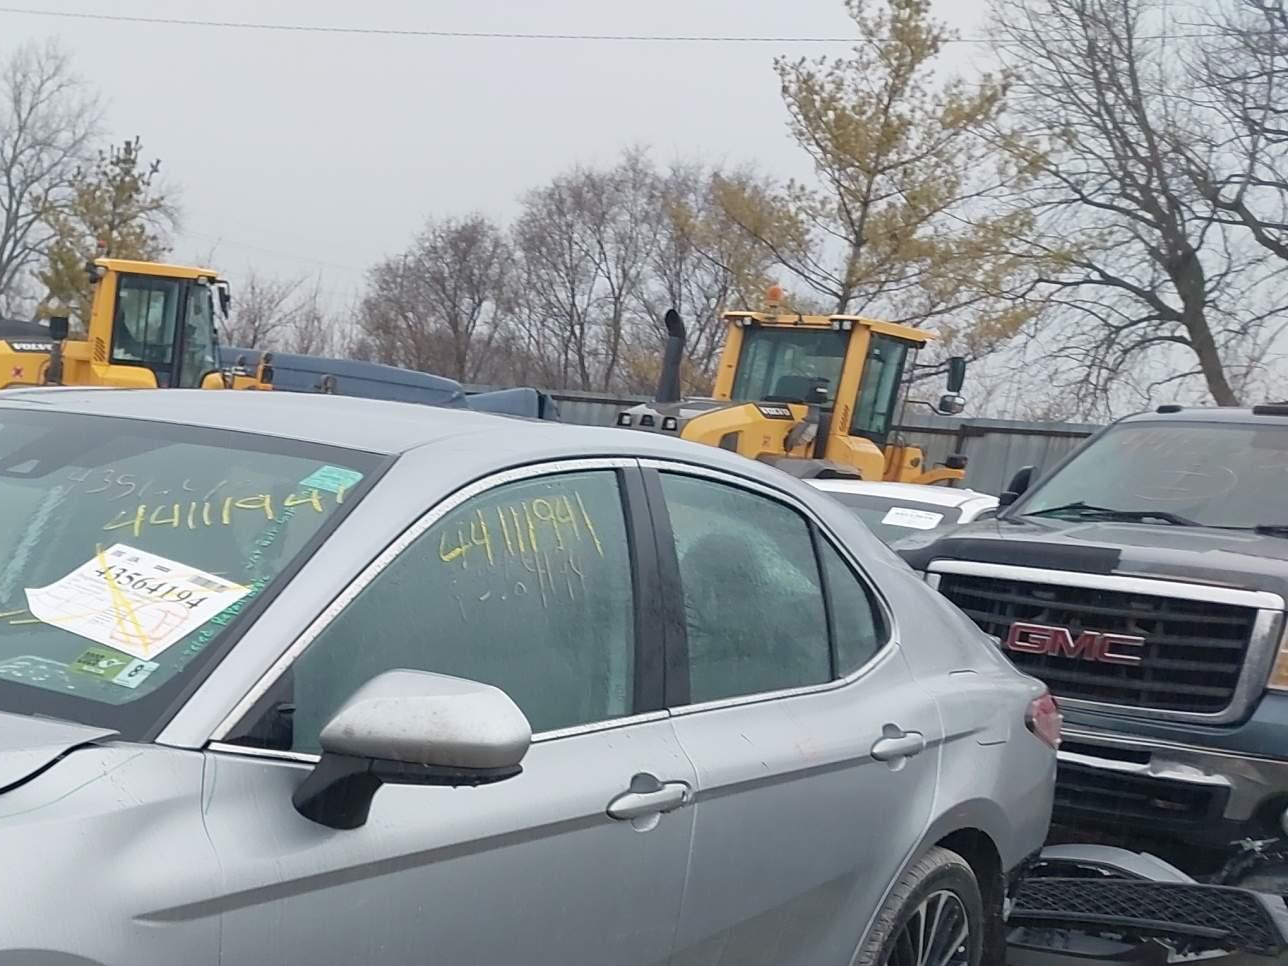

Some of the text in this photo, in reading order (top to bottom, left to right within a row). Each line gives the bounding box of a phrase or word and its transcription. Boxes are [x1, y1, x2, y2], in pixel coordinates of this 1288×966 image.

[439, 491, 605, 569] 44111941
[95, 564, 210, 610] 43564194
[1007, 621, 1147, 667] GMC
